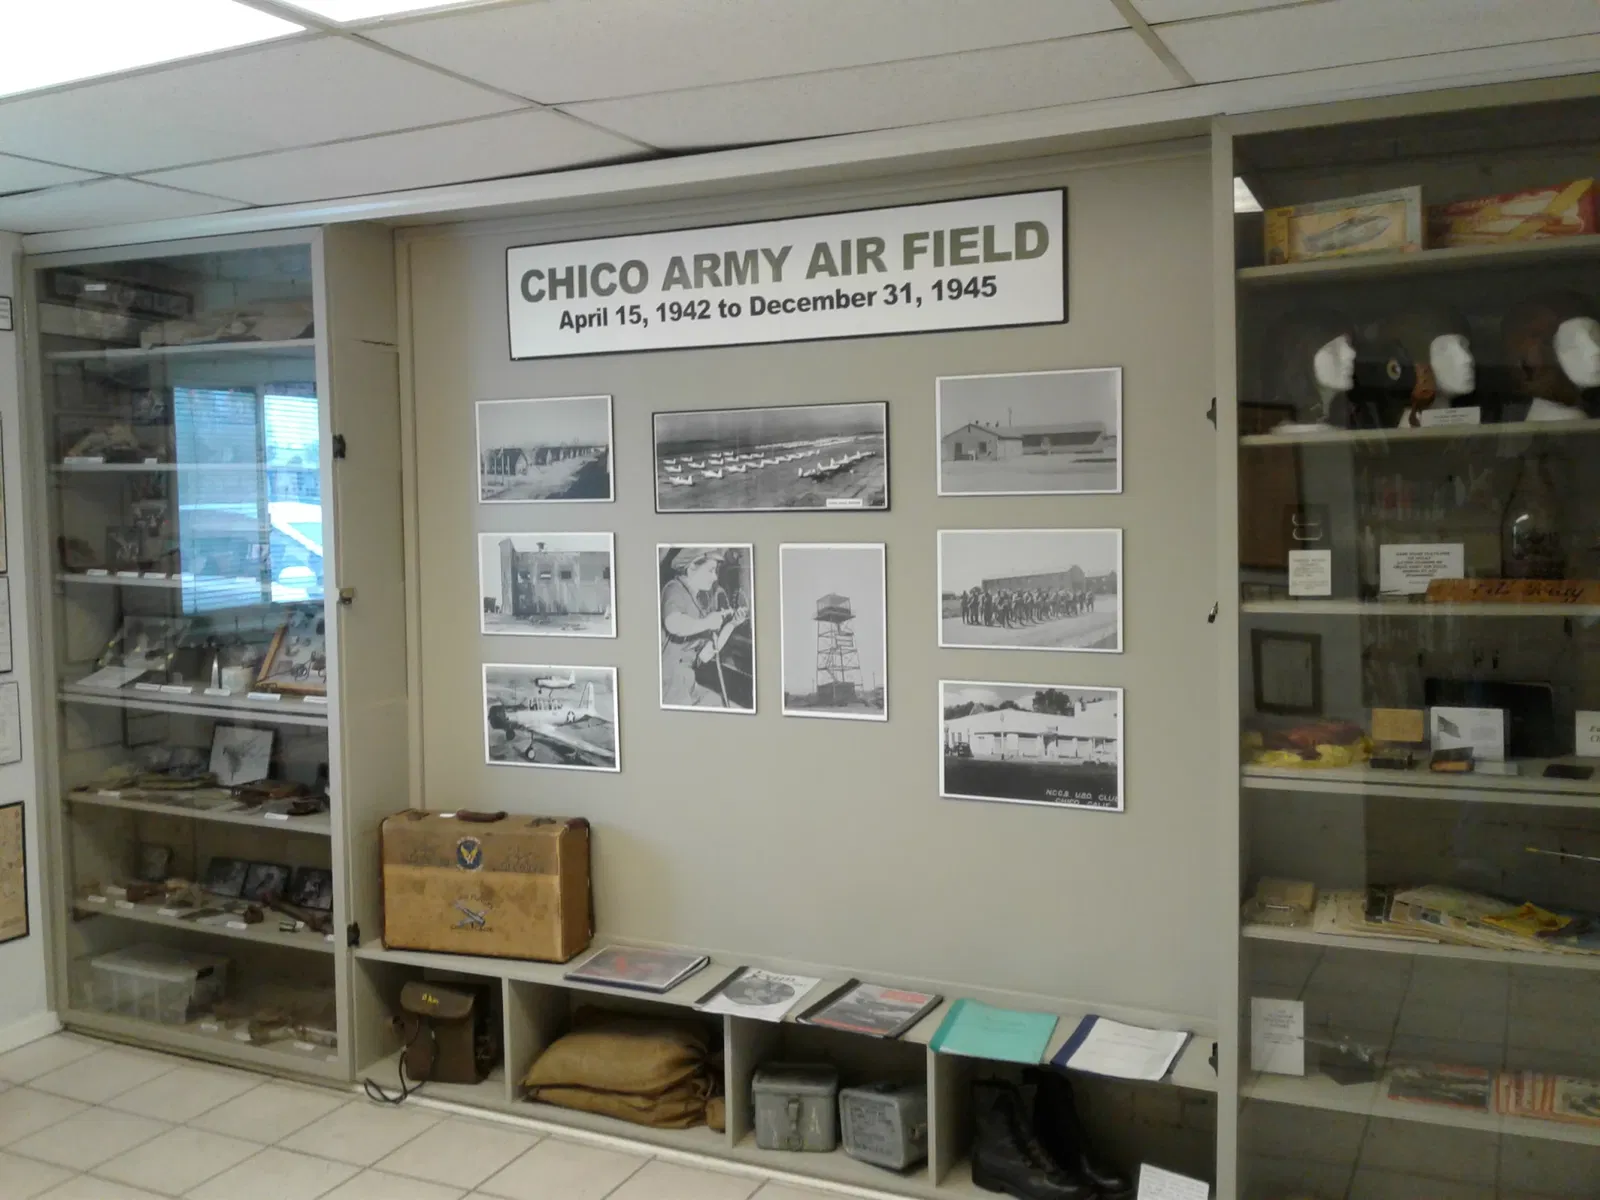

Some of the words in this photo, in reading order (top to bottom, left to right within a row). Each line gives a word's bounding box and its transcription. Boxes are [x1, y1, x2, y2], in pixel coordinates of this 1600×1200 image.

[520, 260, 649, 303] CHICO
[661, 245, 793, 292] ARMY
[806, 236, 887, 279] AIR
[903, 220, 1050, 271] FIELD
[559, 307, 609, 332] April
[615, 304, 649, 329] 15,
[656, 299, 712, 323] 1942
[719, 298, 742, 318] to
[749, 290, 878, 317] December
[883, 283, 923, 310] 31,
[931, 275, 998, 301] 1945
